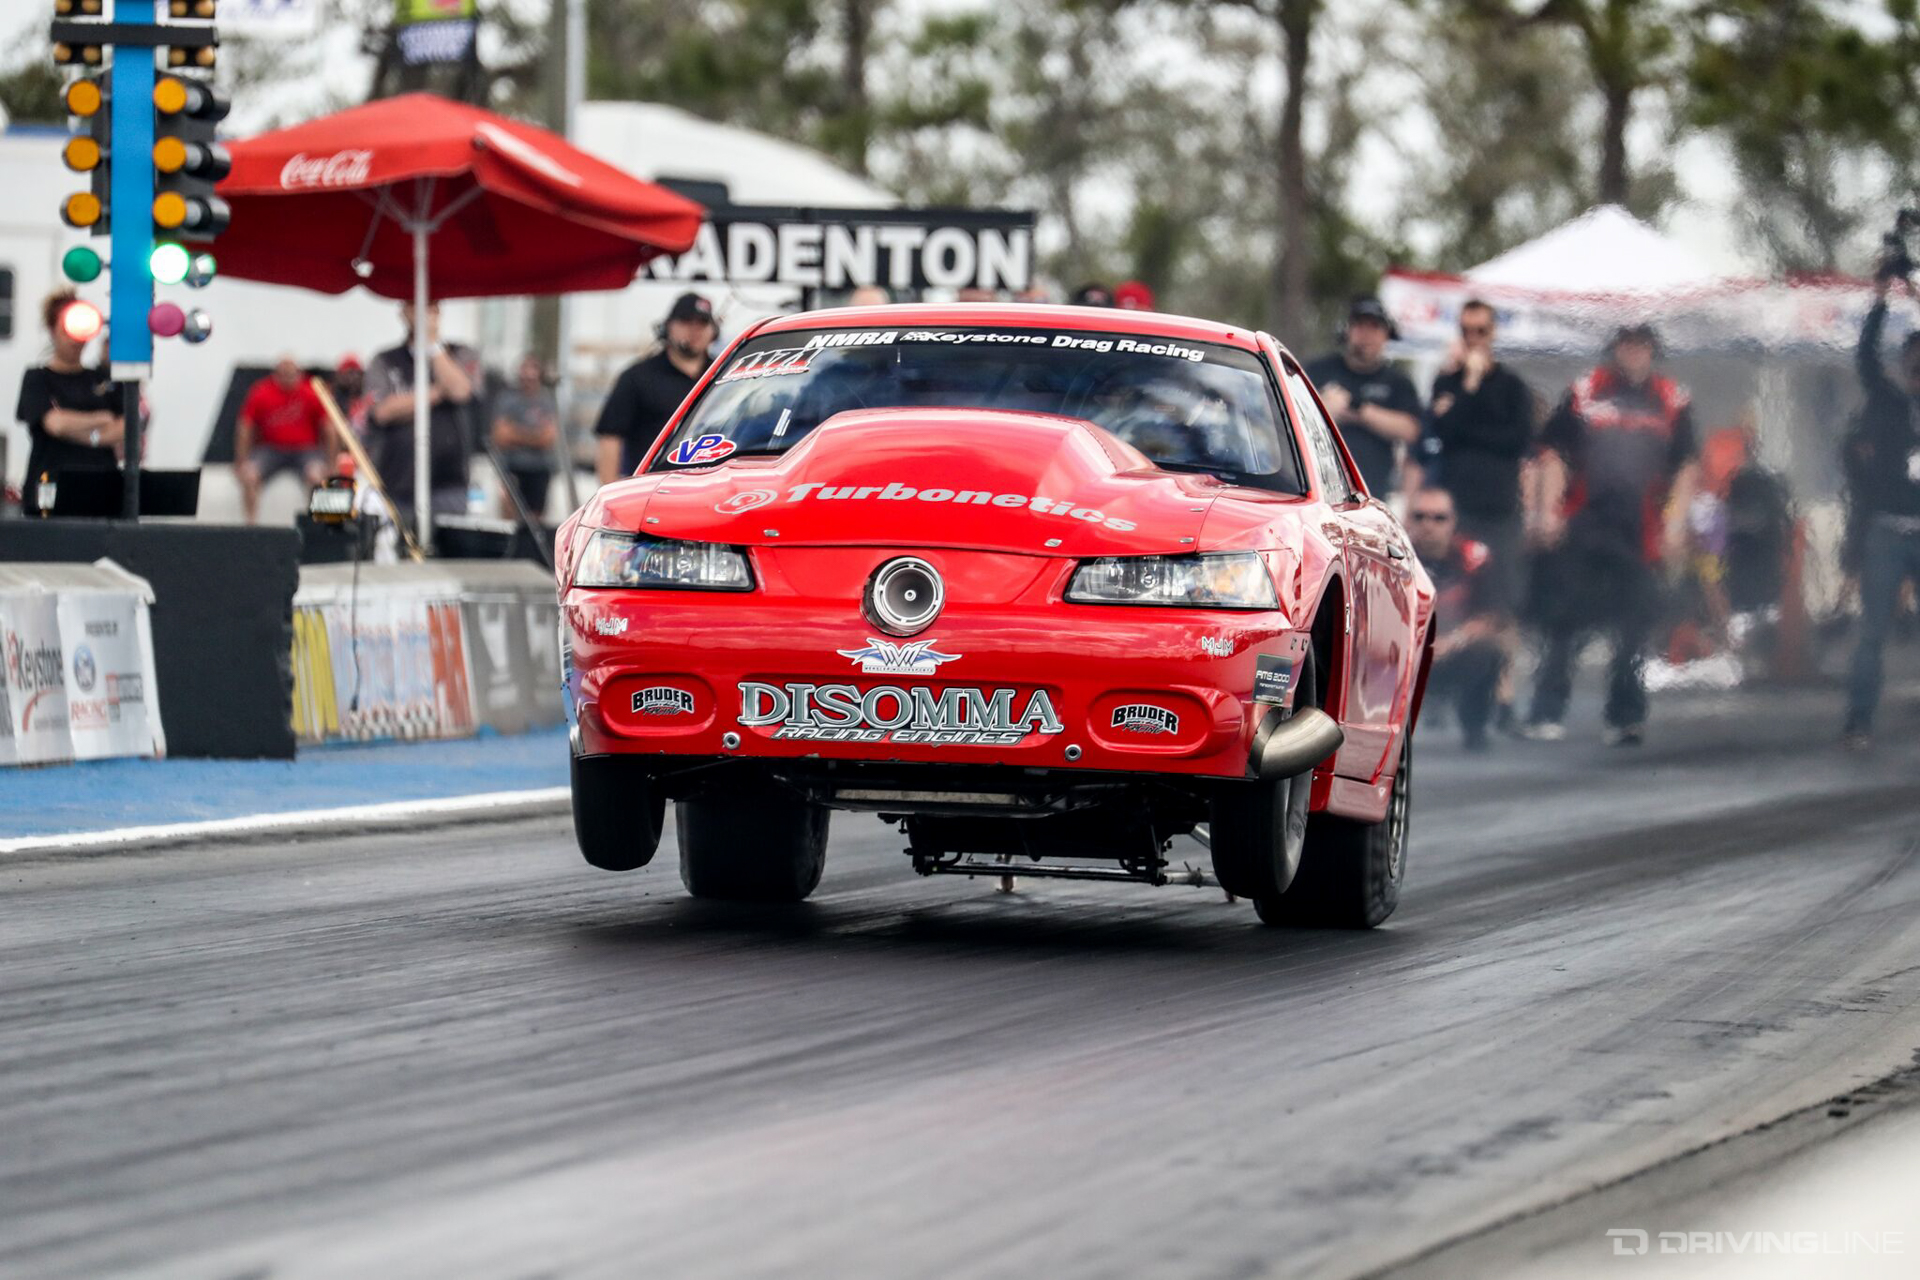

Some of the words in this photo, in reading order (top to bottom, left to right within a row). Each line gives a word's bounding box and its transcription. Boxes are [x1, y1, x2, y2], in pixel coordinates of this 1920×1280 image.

[636, 221, 1031, 290] ADENTON
[804, 331, 899, 349] NMRA
[923, 331, 1048, 345] Keystone
[1051, 335, 1114, 353] Drag
[1116, 339, 1206, 362] Racing
[676, 434, 725, 464] VP
[786, 482, 1138, 532] Turbonetics
[1201, 636, 1235, 654] MJM
[1255, 669, 1273, 681] AMS
[1272, 672, 1291, 684] 2000
[631, 687, 695, 714] BRUDER
[737, 682, 1065, 733] DISOMMA
[772, 725, 888, 742] RACING
[890, 728, 1026, 745] ENGINES
[1111, 704, 1180, 736] BRUDER
